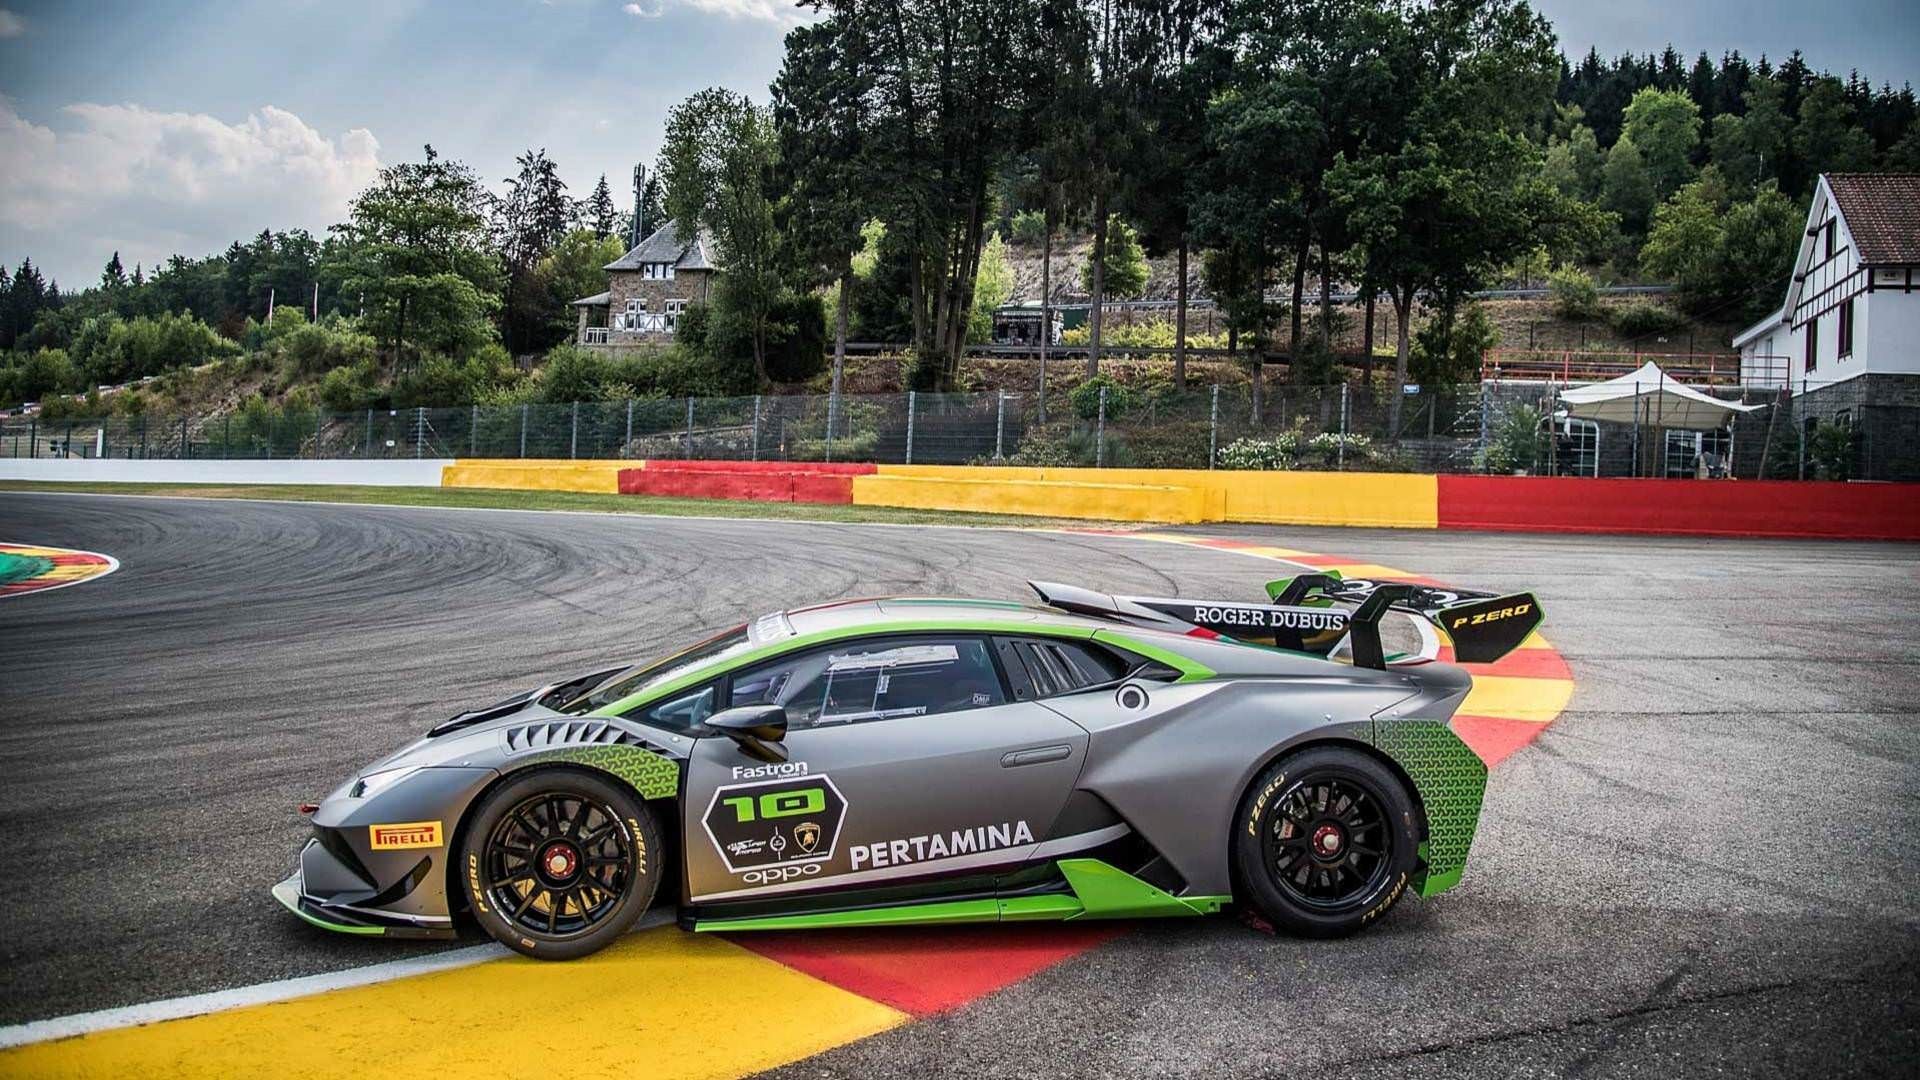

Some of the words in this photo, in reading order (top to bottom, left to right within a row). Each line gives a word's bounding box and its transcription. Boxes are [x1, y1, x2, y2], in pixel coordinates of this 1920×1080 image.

[1193, 606, 1266, 626] ROGER
[1269, 611, 1345, 631] DUBUIS
[1471, 603, 1530, 625] ZERO
[732, 761, 808, 780] Fastron
[723, 787, 826, 823] 10
[375, 826, 435, 845] PIRELLI
[628, 818, 647, 875] PIRELLI
[850, 820, 1035, 871] PERTAMINA
[743, 863, 822, 885] oppo
